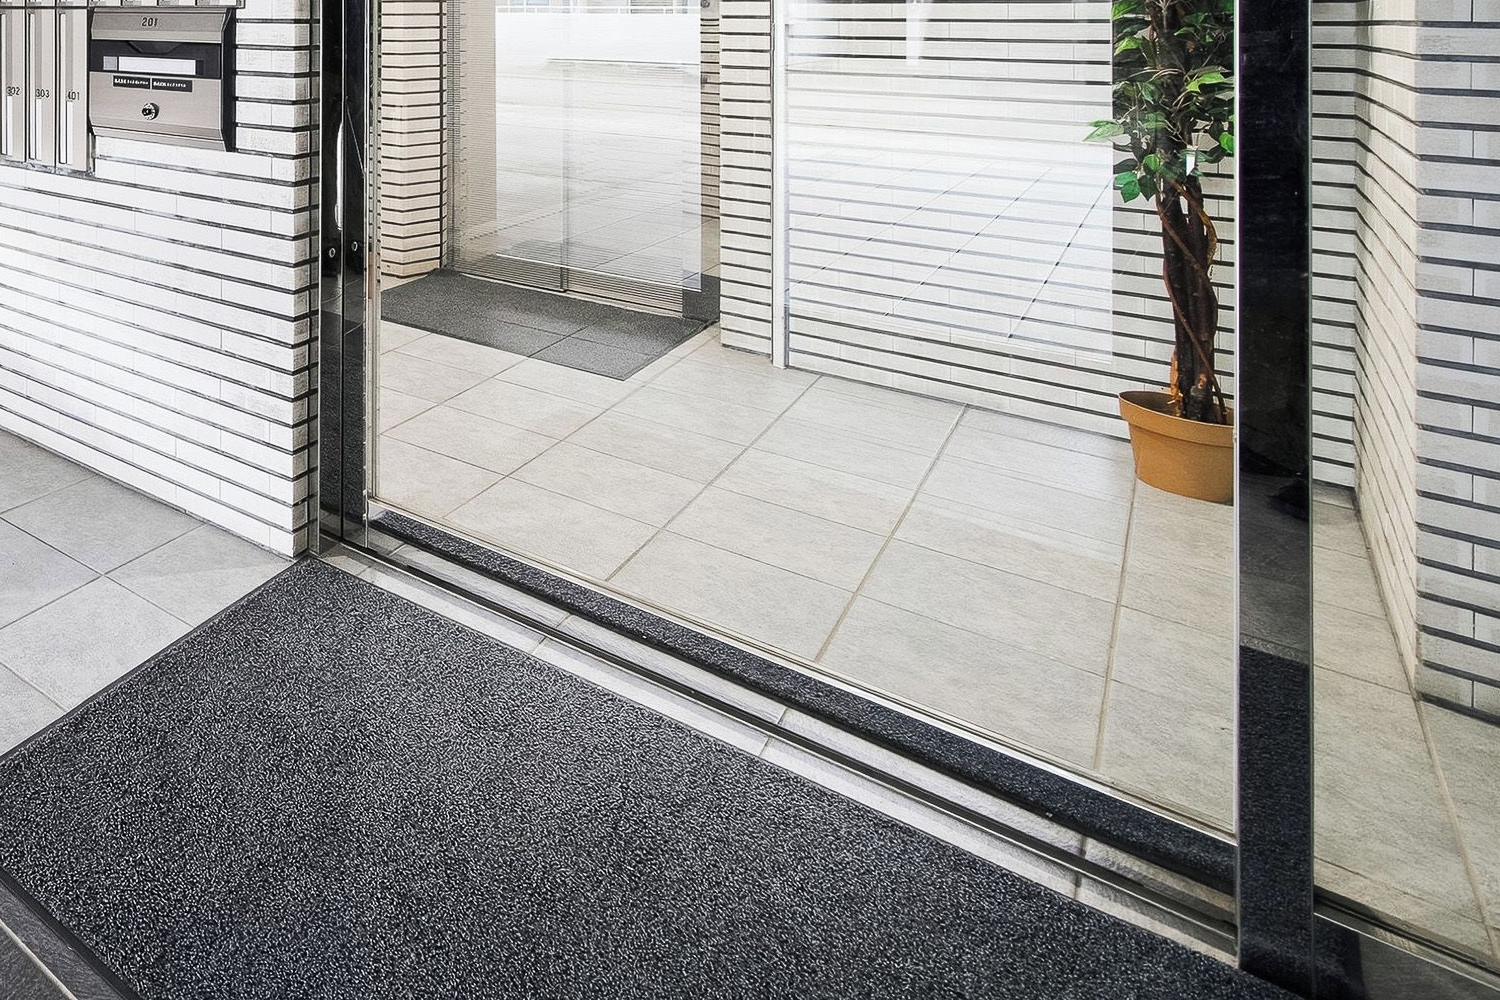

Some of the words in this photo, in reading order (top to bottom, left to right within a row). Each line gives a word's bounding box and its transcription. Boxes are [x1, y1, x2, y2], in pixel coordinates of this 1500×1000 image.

[141, 16, 158, 27] 201
[8, 86, 20, 96] 302
[36, 88, 50, 98] 303
